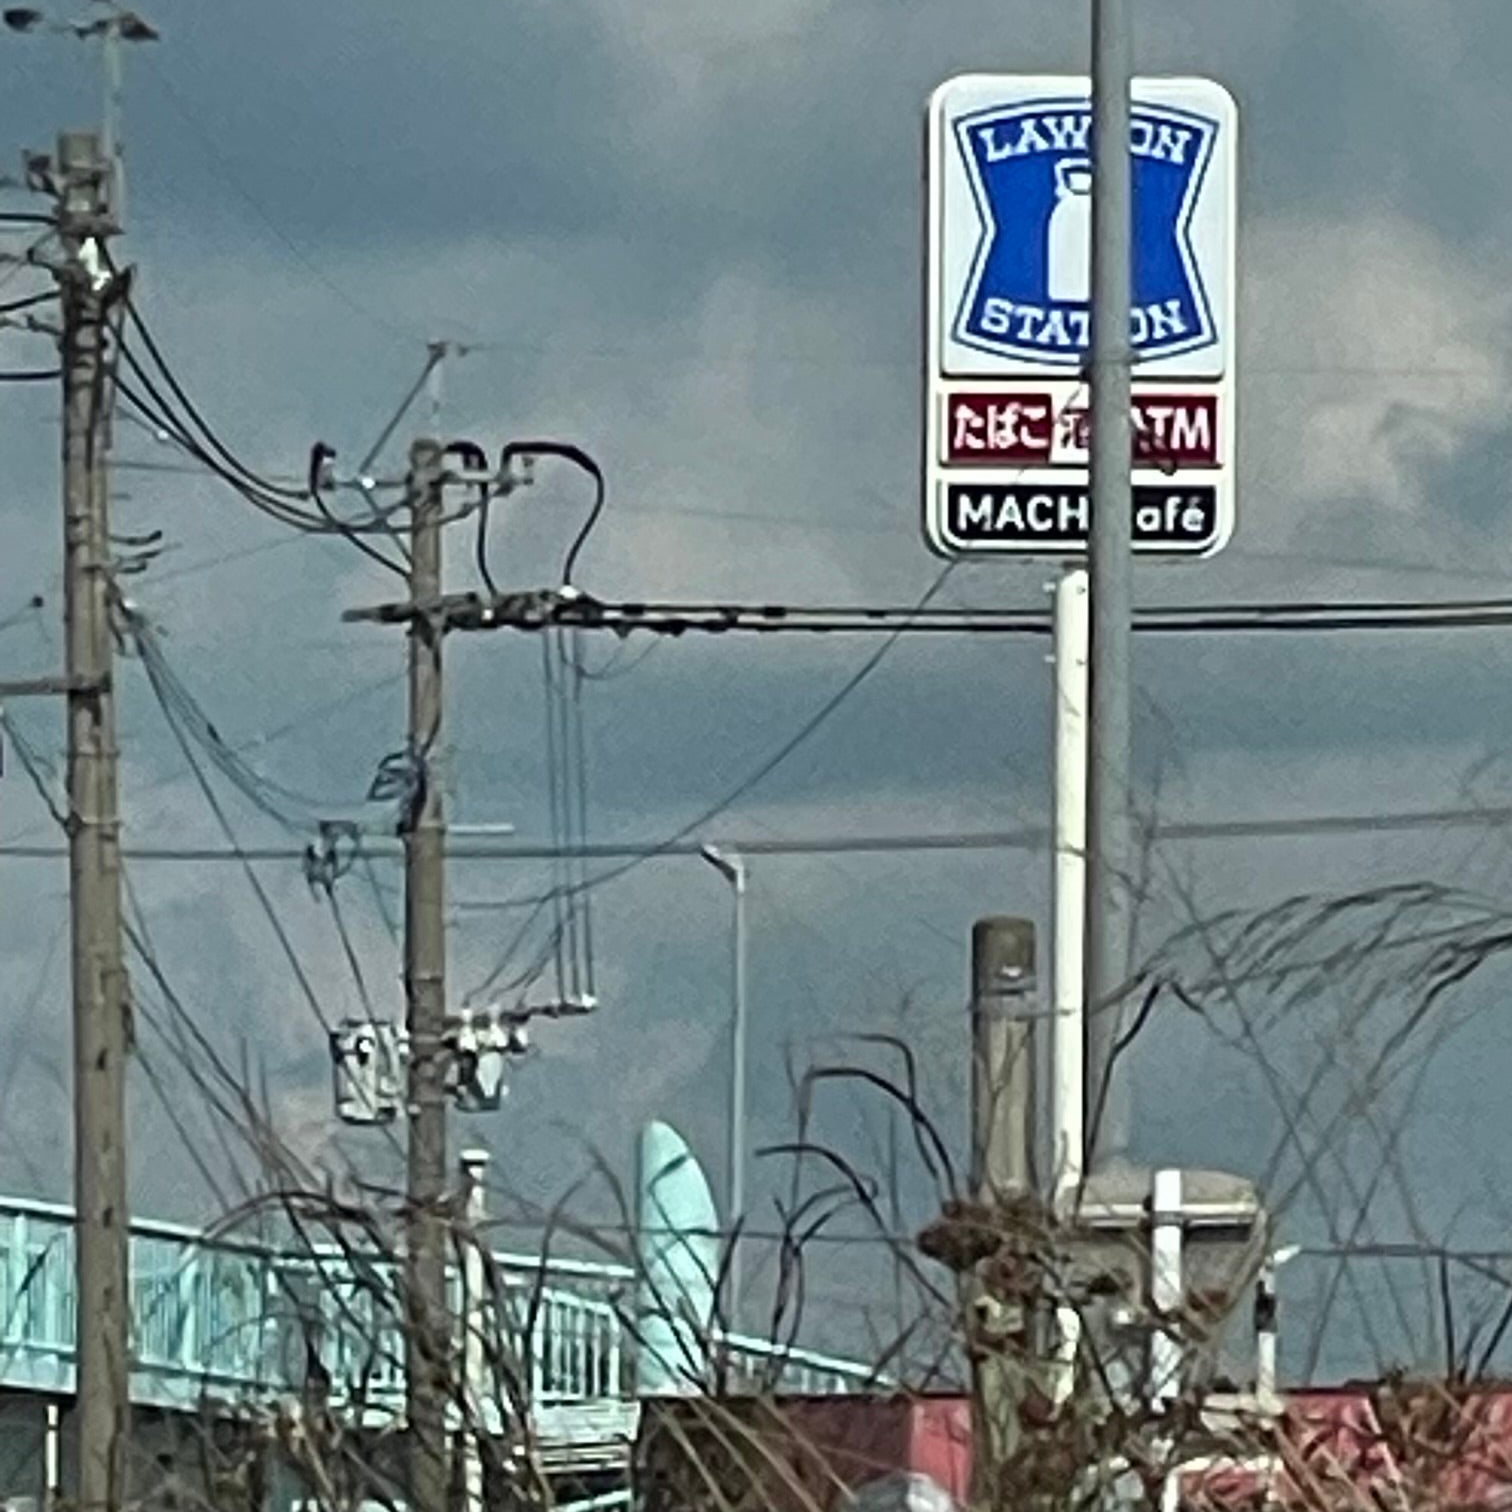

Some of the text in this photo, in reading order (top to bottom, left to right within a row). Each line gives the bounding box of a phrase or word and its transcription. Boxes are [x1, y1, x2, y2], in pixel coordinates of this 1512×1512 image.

[978, 115, 1192, 164] LAWON
[981, 298, 1186, 346] STATON
[954, 402, 1048, 449] たばこ
[957, 494, 1205, 532] MACH afé
